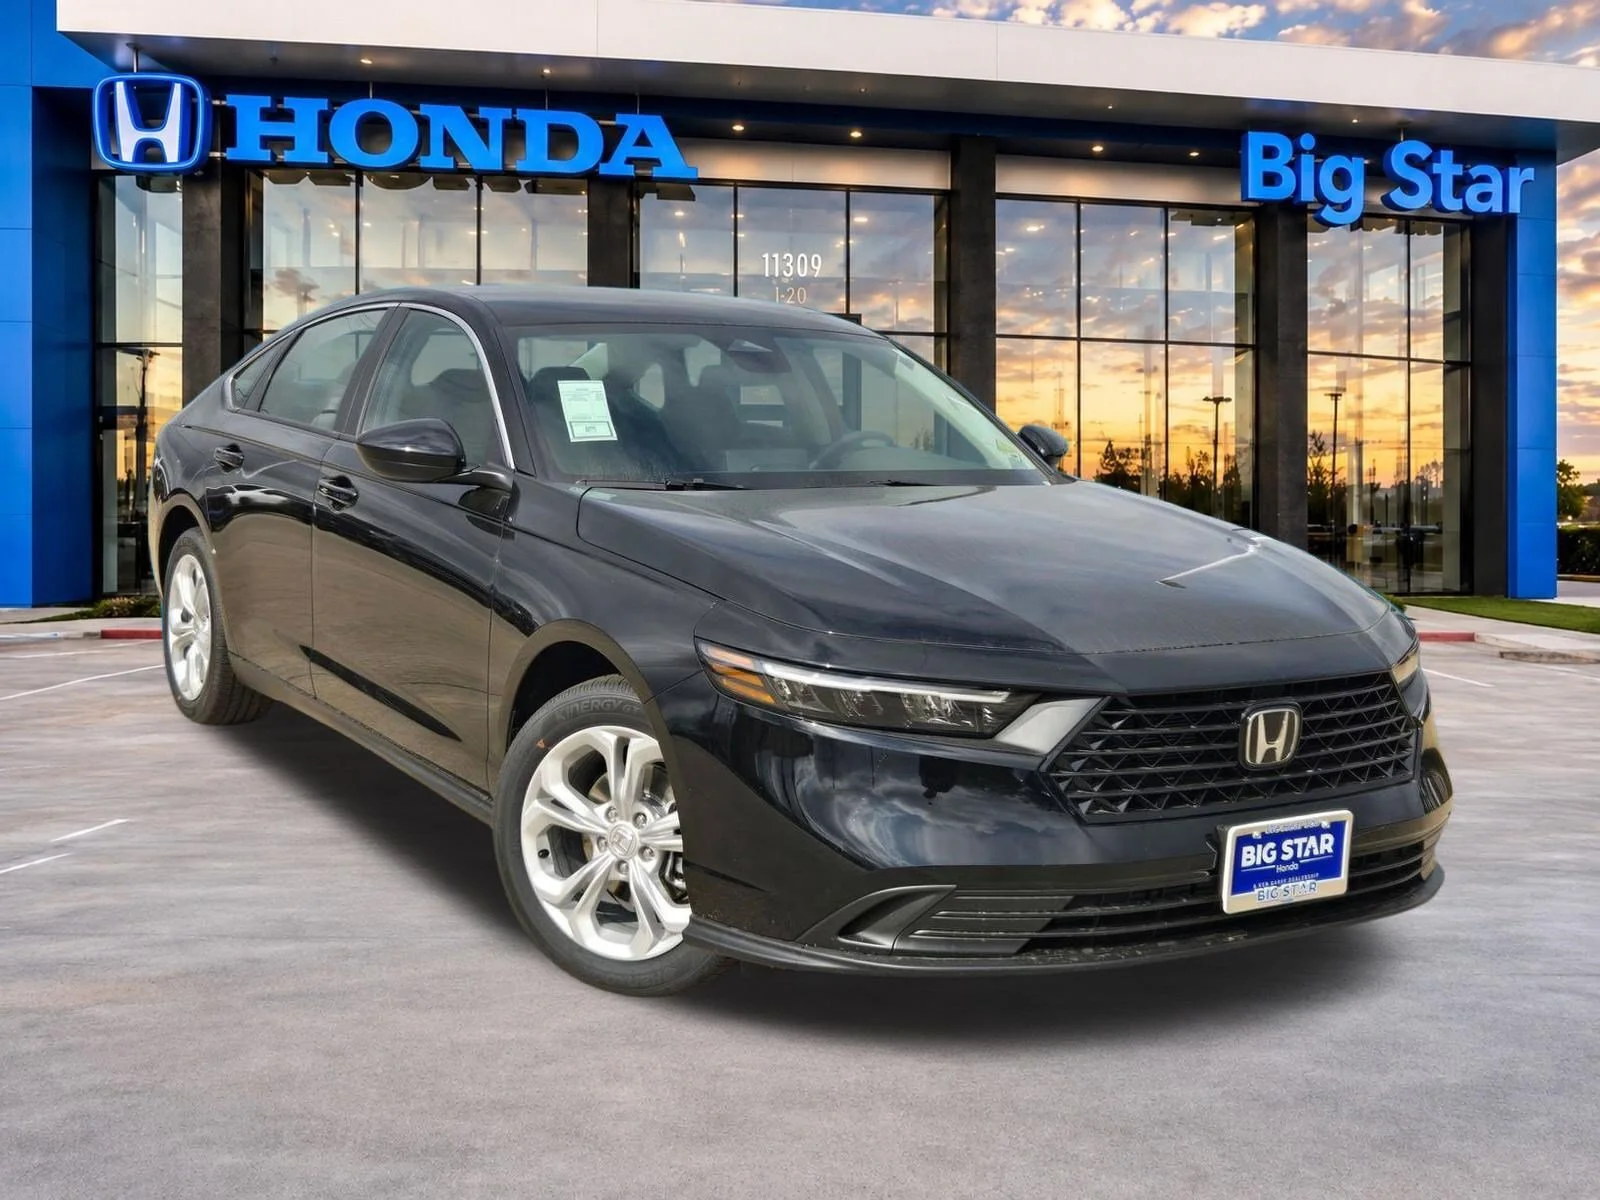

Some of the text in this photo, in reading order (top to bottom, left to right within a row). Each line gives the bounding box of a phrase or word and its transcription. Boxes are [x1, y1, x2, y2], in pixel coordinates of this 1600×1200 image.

[226, 94, 698, 180] HONDA
[1242, 131, 1535, 226] Big Star
[762, 252, 822, 278] 11309
[1240, 833, 1335, 868] BIG STAR
[1275, 861, 1299, 873] Honda
[1257, 881, 1317, 901] BIG STAR
